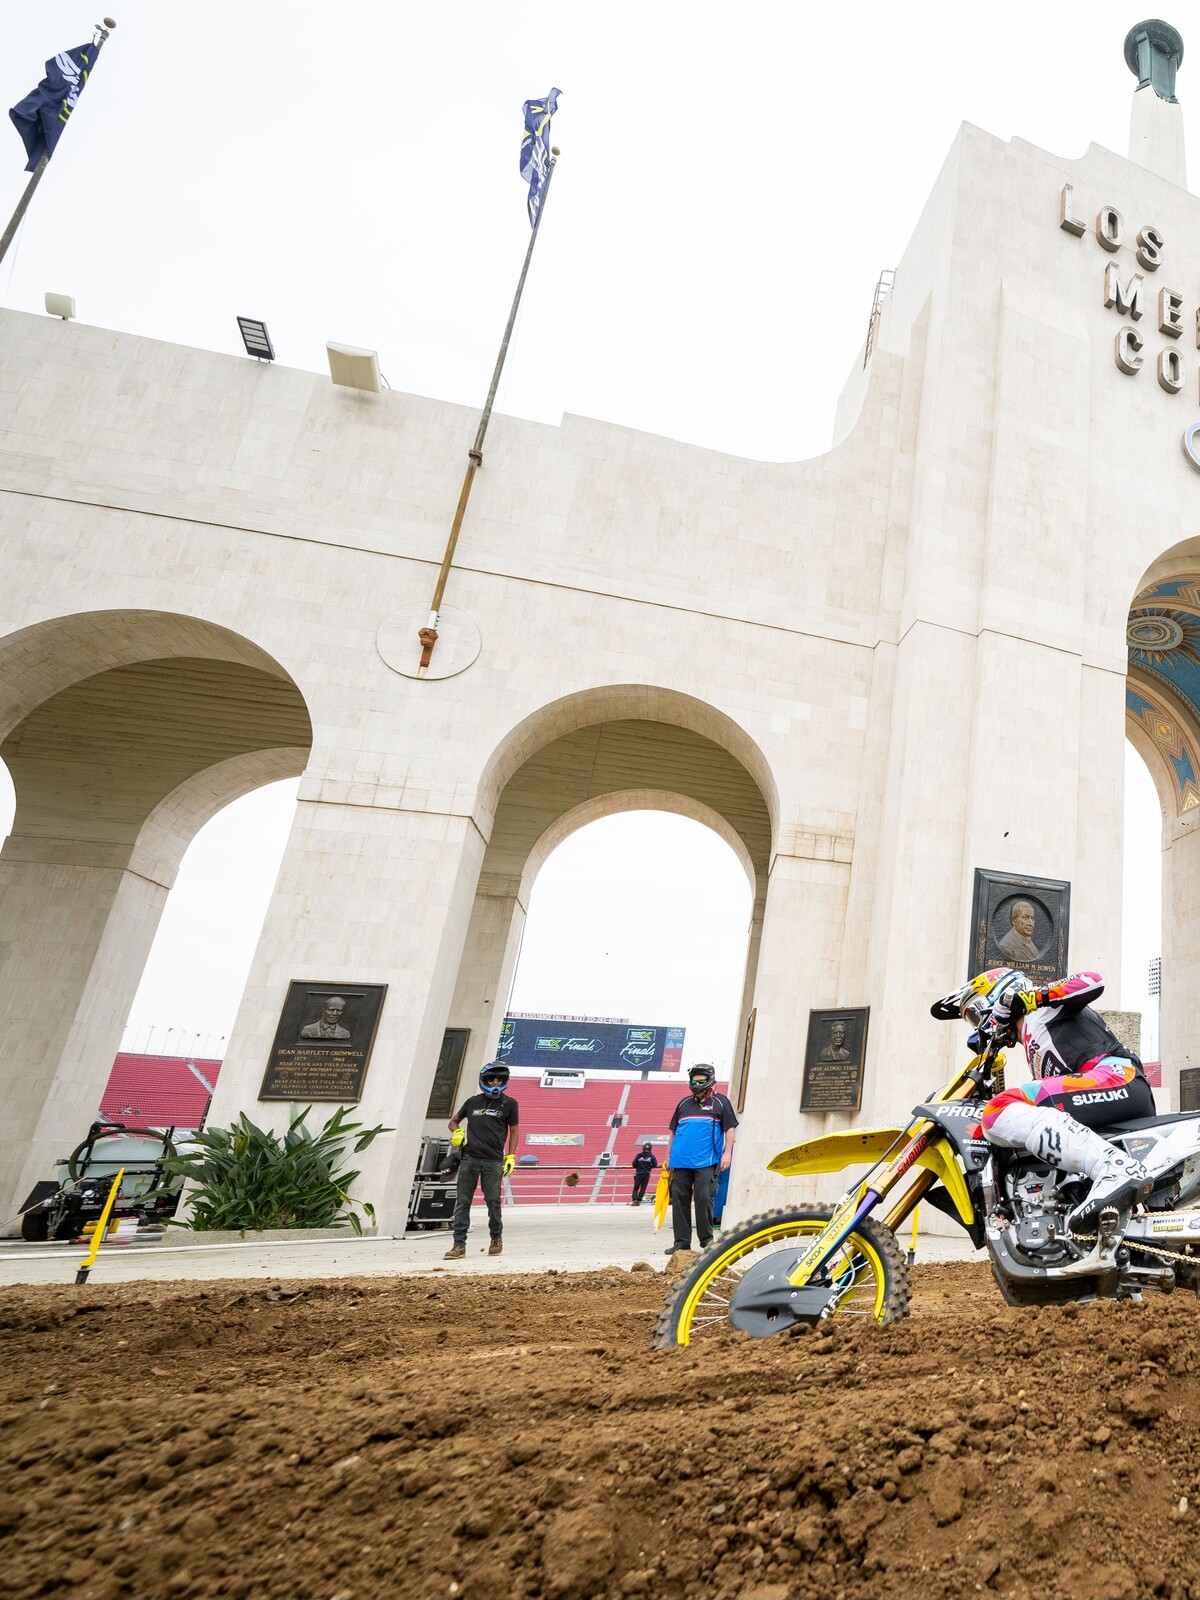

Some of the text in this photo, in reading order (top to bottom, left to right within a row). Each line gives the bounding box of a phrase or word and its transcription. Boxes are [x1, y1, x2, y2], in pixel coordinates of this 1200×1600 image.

[1060, 183, 1164, 272] LOS
[988, 959, 1004, 967] JUDGE
[1006, 961, 1030, 969] WILLIAM
[561, 1038, 595, 1051] Finals
[620, 1041, 656, 1056] Finals
[1072, 1088, 1129, 1106] SUZUKI
[962, 1138, 991, 1147] SUZUKI
[898, 1136, 927, 1176] SHOWA
[1080, 1201, 1096, 1219] FOX
[806, 1246, 824, 1267] SKDA
